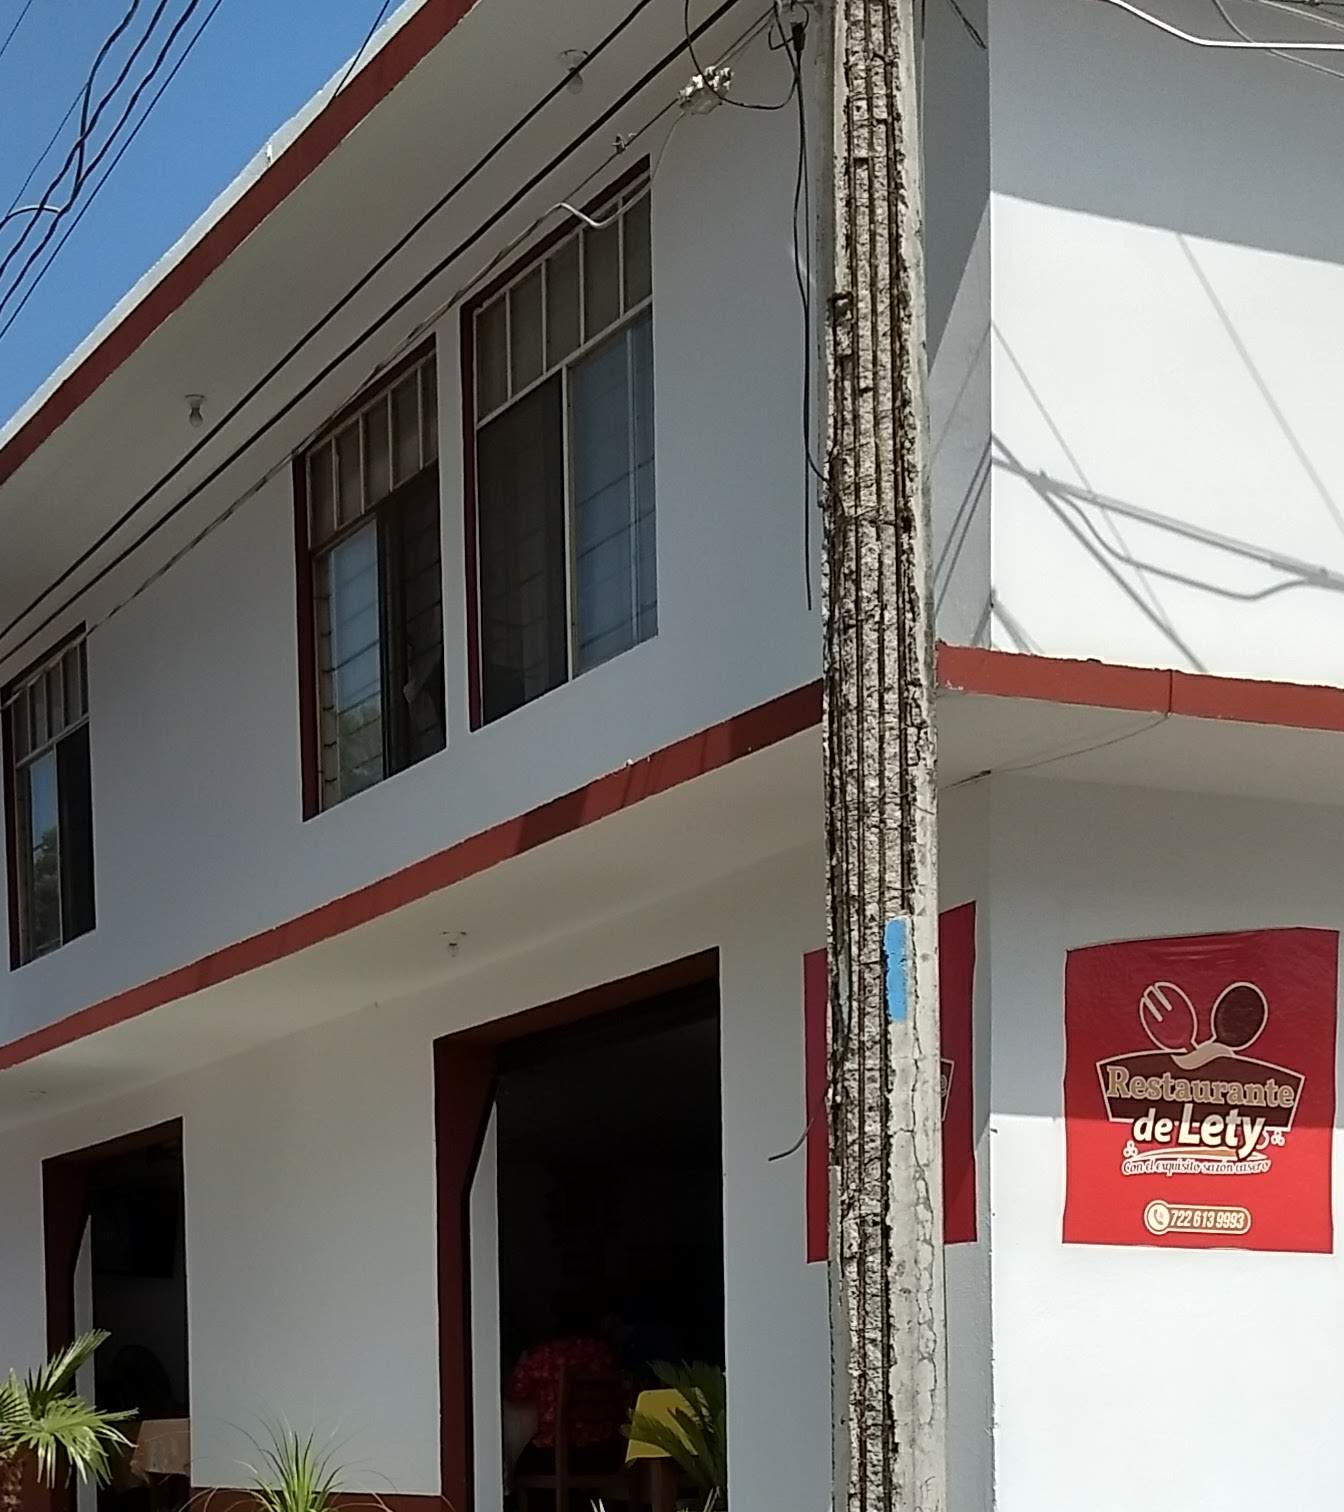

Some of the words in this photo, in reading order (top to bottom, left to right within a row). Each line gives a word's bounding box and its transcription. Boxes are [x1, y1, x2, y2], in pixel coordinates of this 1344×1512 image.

[1106, 1065, 1295, 1108] Restaurante
[1133, 1107, 1173, 1143] de
[1178, 1103, 1266, 1159] Lety
[1123, 1160, 1143, 1174] Con
[1155, 1159, 1200, 1175] exquisito
[1235, 1160, 1270, 1173] casero
[1170, 1209, 1193, 1227] 722
[1193, 1210, 1215, 1228] 613
[1216, 1212, 1245, 1229] 9993
